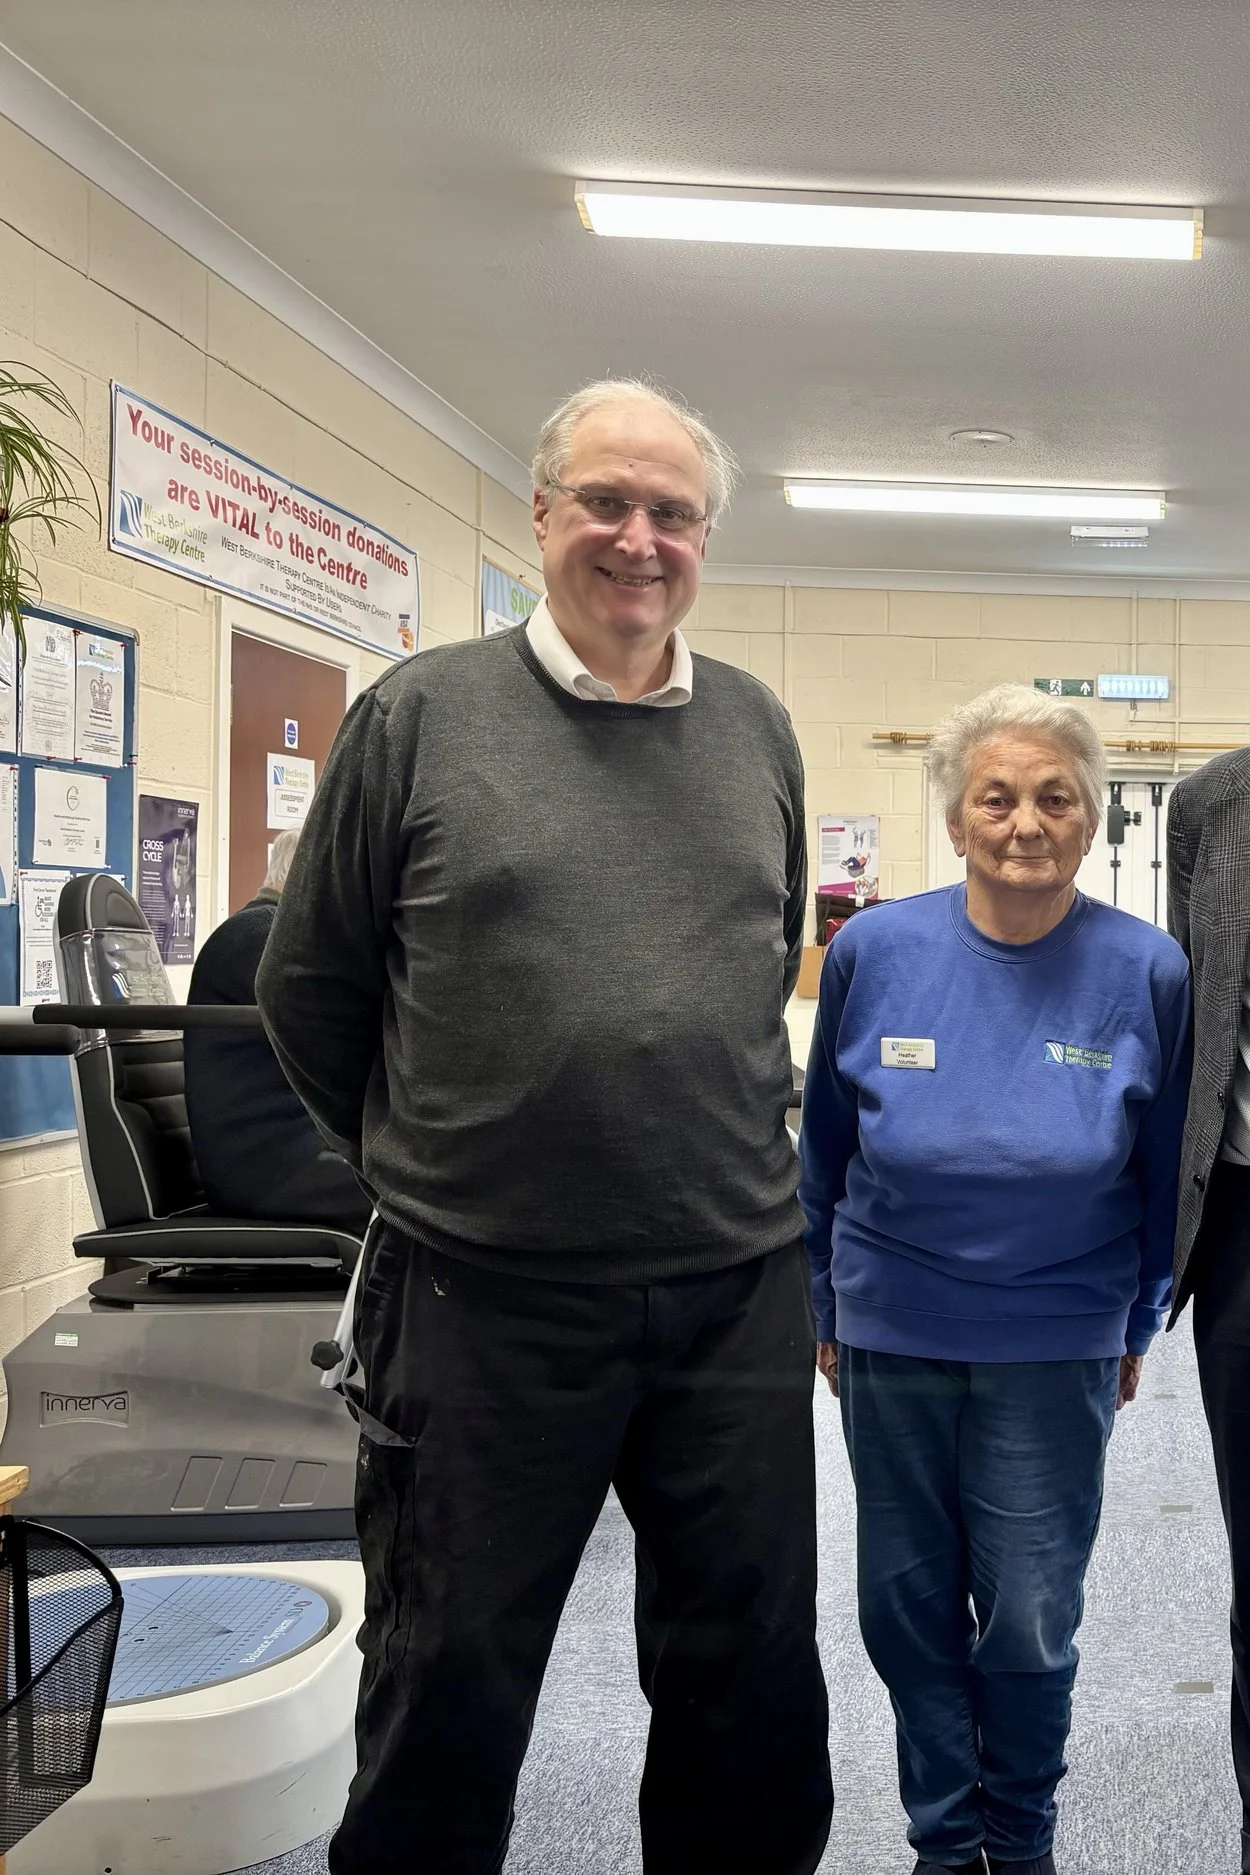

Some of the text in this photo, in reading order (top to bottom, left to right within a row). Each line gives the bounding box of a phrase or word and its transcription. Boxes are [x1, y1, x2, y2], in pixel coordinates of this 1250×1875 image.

[127, 403, 409, 577] Your session-by-session donations
[144, 502, 208, 545] West Berkshire
[168, 479, 368, 590] are VITAL to the Centre
[144, 523, 205, 563] Therapy Centre
[142, 840, 164, 851] CROSS
[142, 852, 162, 862] CYCLE
[1065, 1046, 1113, 1062] West Berkshire
[1065, 1055, 1112, 1069] Therapy Centre
[46, 1393, 126, 1411] innerva
[239, 1640, 274, 1663] Balance
[263, 1619, 295, 1641] System
